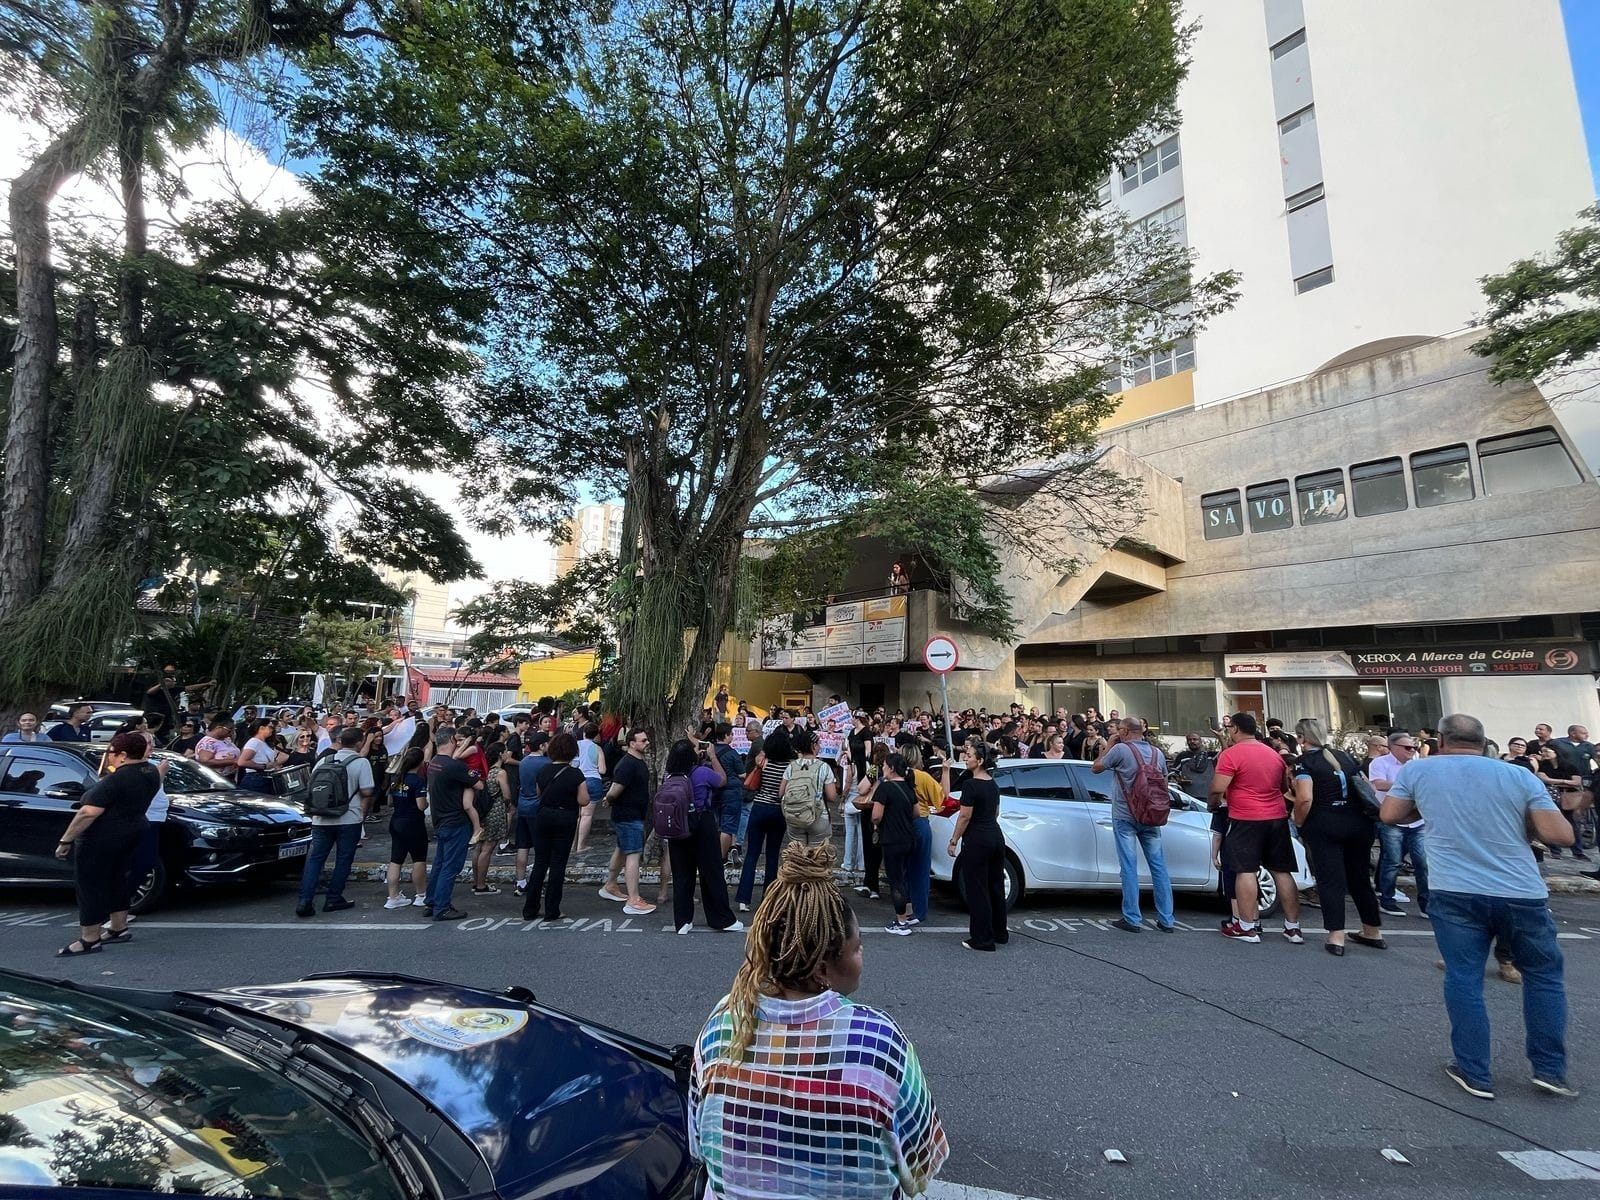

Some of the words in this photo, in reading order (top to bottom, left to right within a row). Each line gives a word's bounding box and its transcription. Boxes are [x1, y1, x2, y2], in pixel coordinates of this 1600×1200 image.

[1358, 653, 1402, 663] XEROX
[1406, 652, 1417, 662] A
[1421, 652, 1464, 662] Marca
[1468, 650, 1486, 661] da
[1491, 649, 1535, 661] Cópia
[1365, 666, 1427, 674] COPIADORA
[1429, 664, 1463, 673] GROH
[457, 917, 643, 932] OFICIAL
